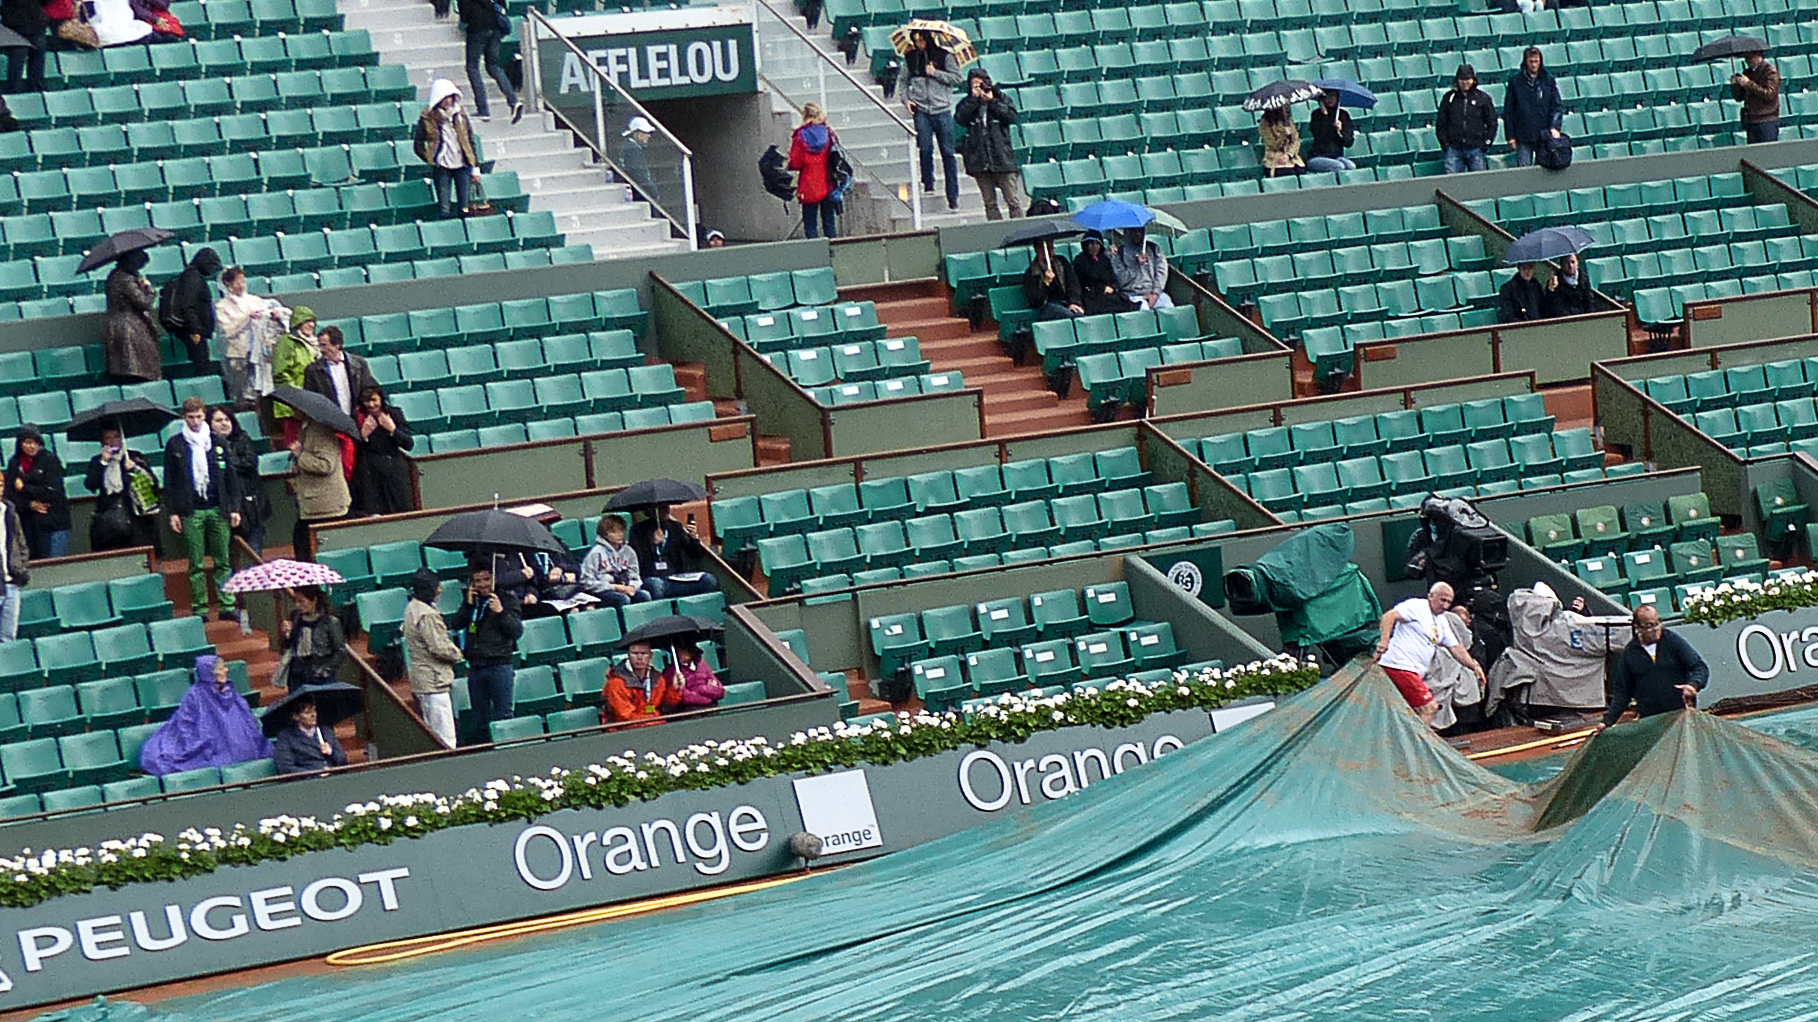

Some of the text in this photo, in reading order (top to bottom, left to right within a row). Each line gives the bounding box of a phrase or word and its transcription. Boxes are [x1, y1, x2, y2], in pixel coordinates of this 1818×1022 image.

[559, 39, 740, 95] AFFLELOU
[514, 805, 770, 891] Orange
[821, 828, 873, 848] range
[17, 867, 410, 972] PEUGEOT
